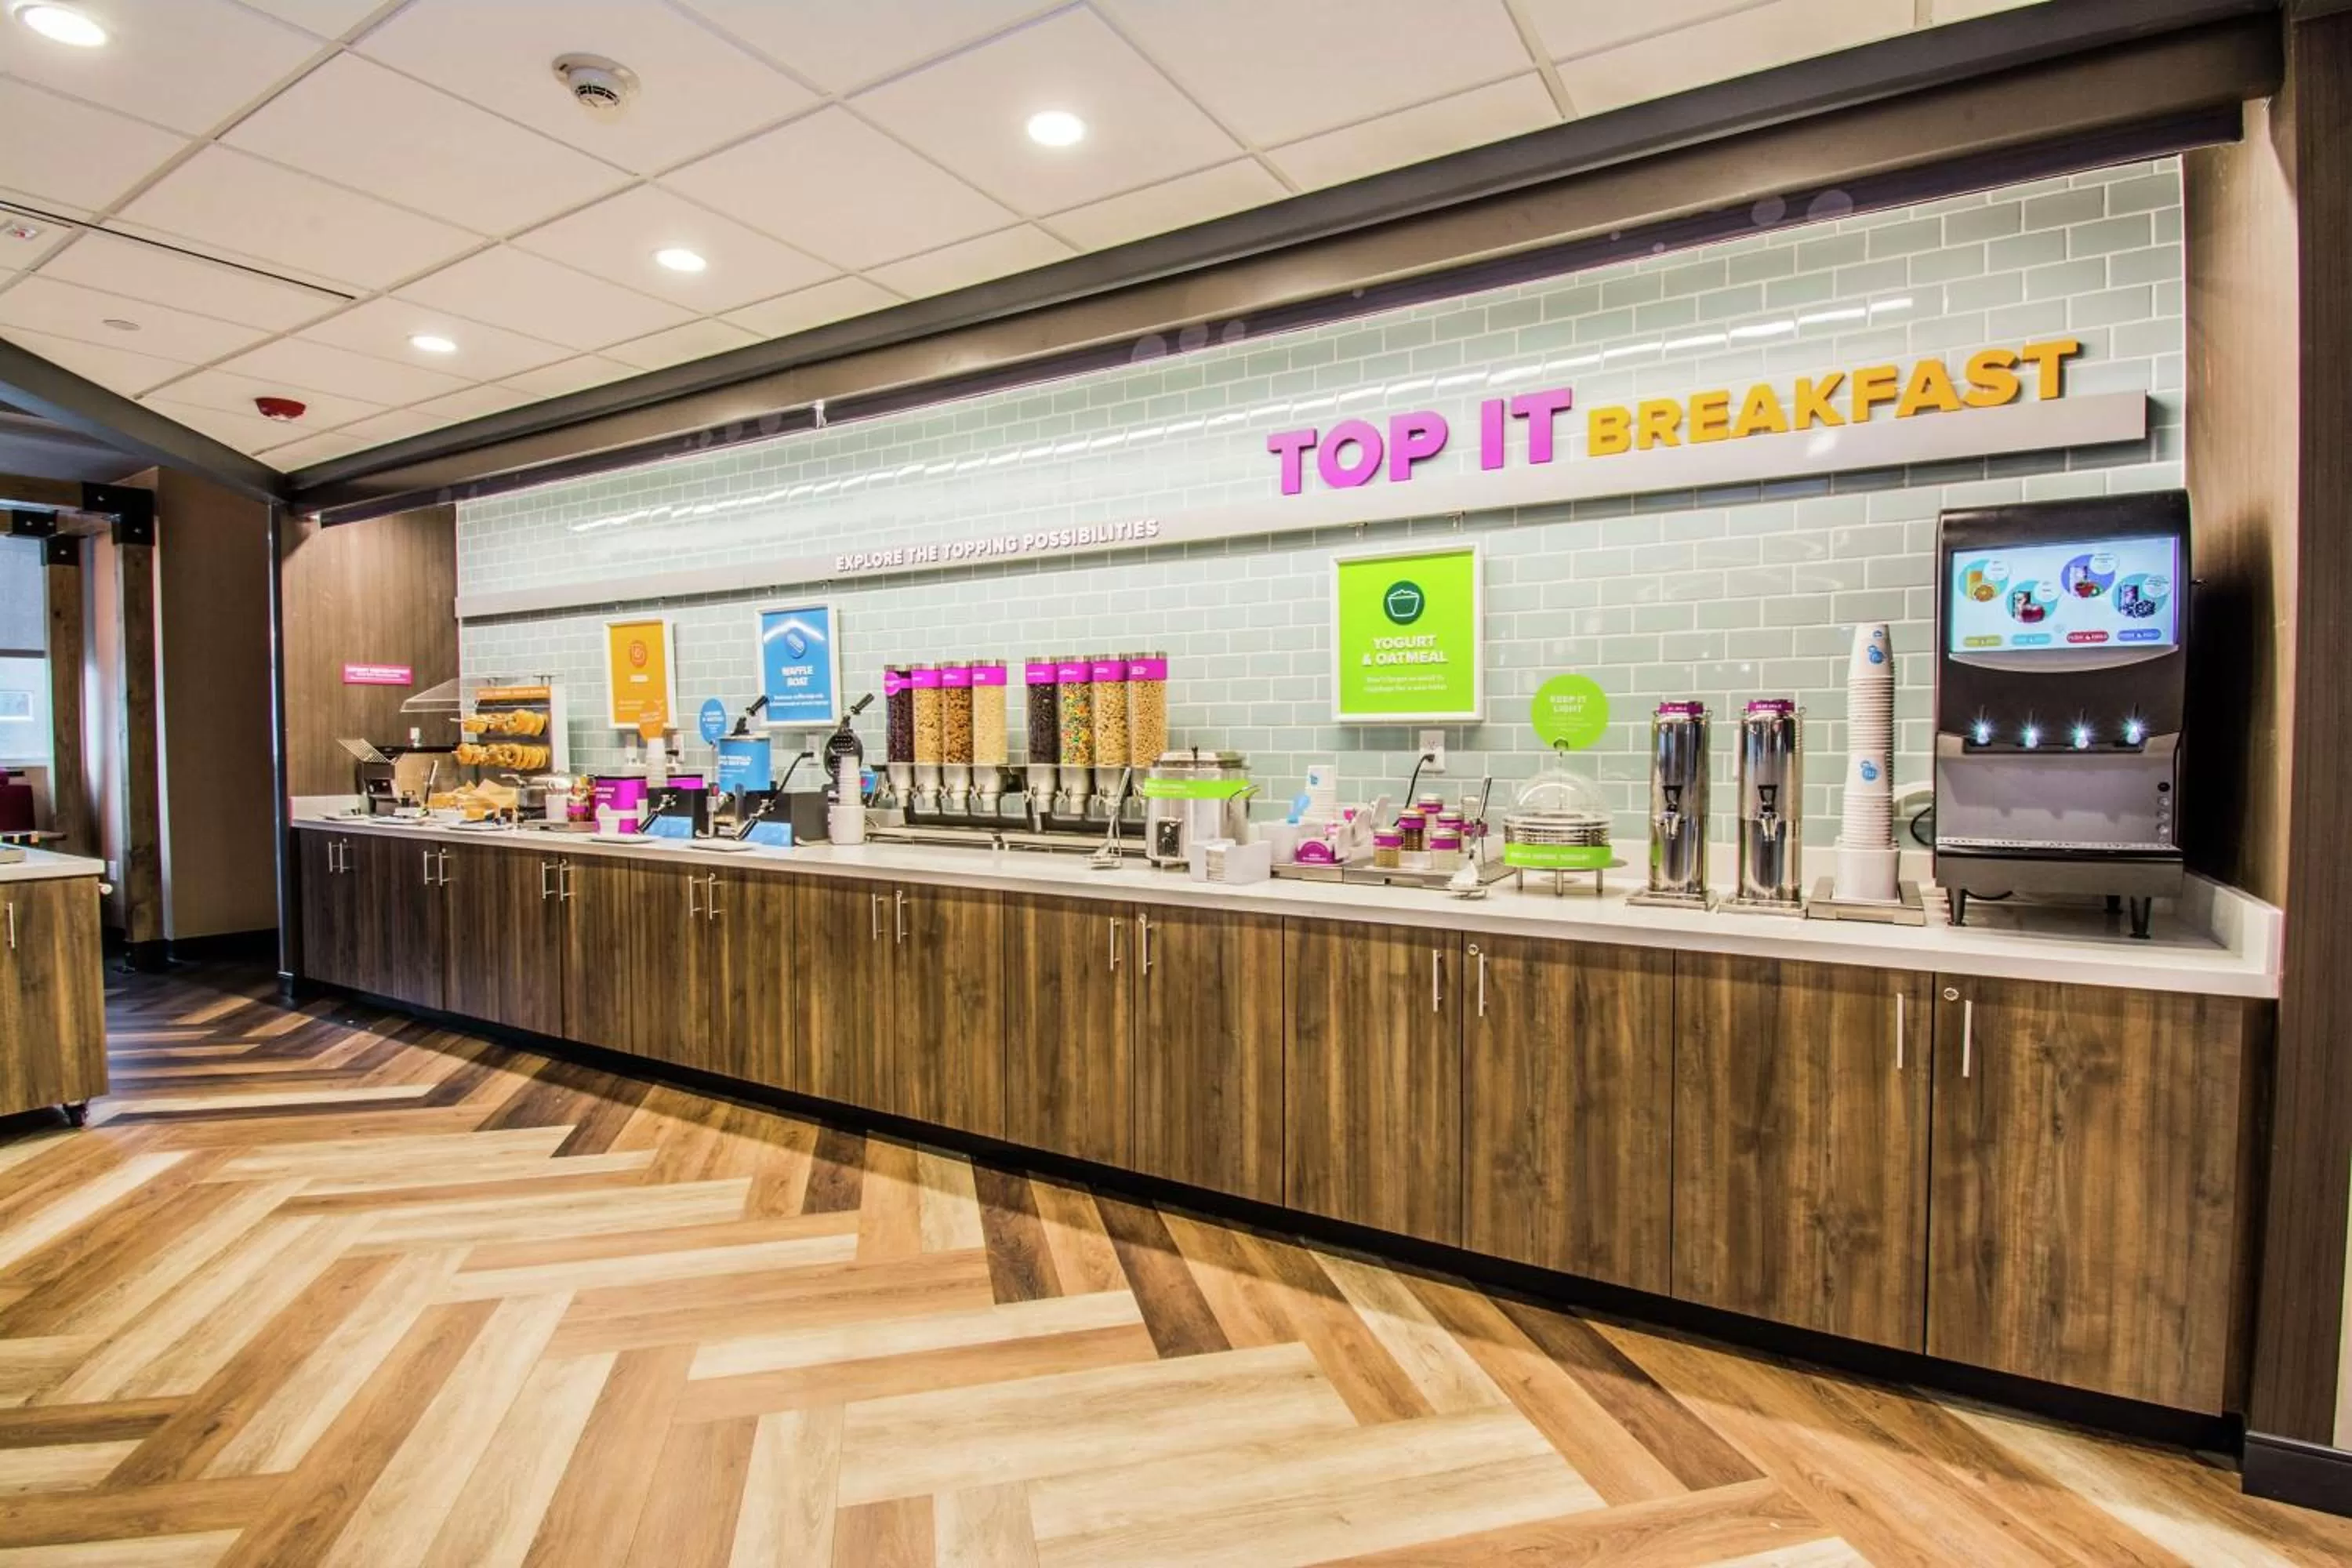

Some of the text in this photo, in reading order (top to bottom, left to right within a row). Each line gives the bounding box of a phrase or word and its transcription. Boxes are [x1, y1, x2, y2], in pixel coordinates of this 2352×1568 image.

[1267, 339, 2082, 495] TOP IT BREAKFAST
[836, 519, 1160, 572] EXPLORE THE TOPPING POSSIBILITIES
[1362, 650, 1449, 666] & OATMEAL
[1373, 633, 1437, 650] YOGURT
